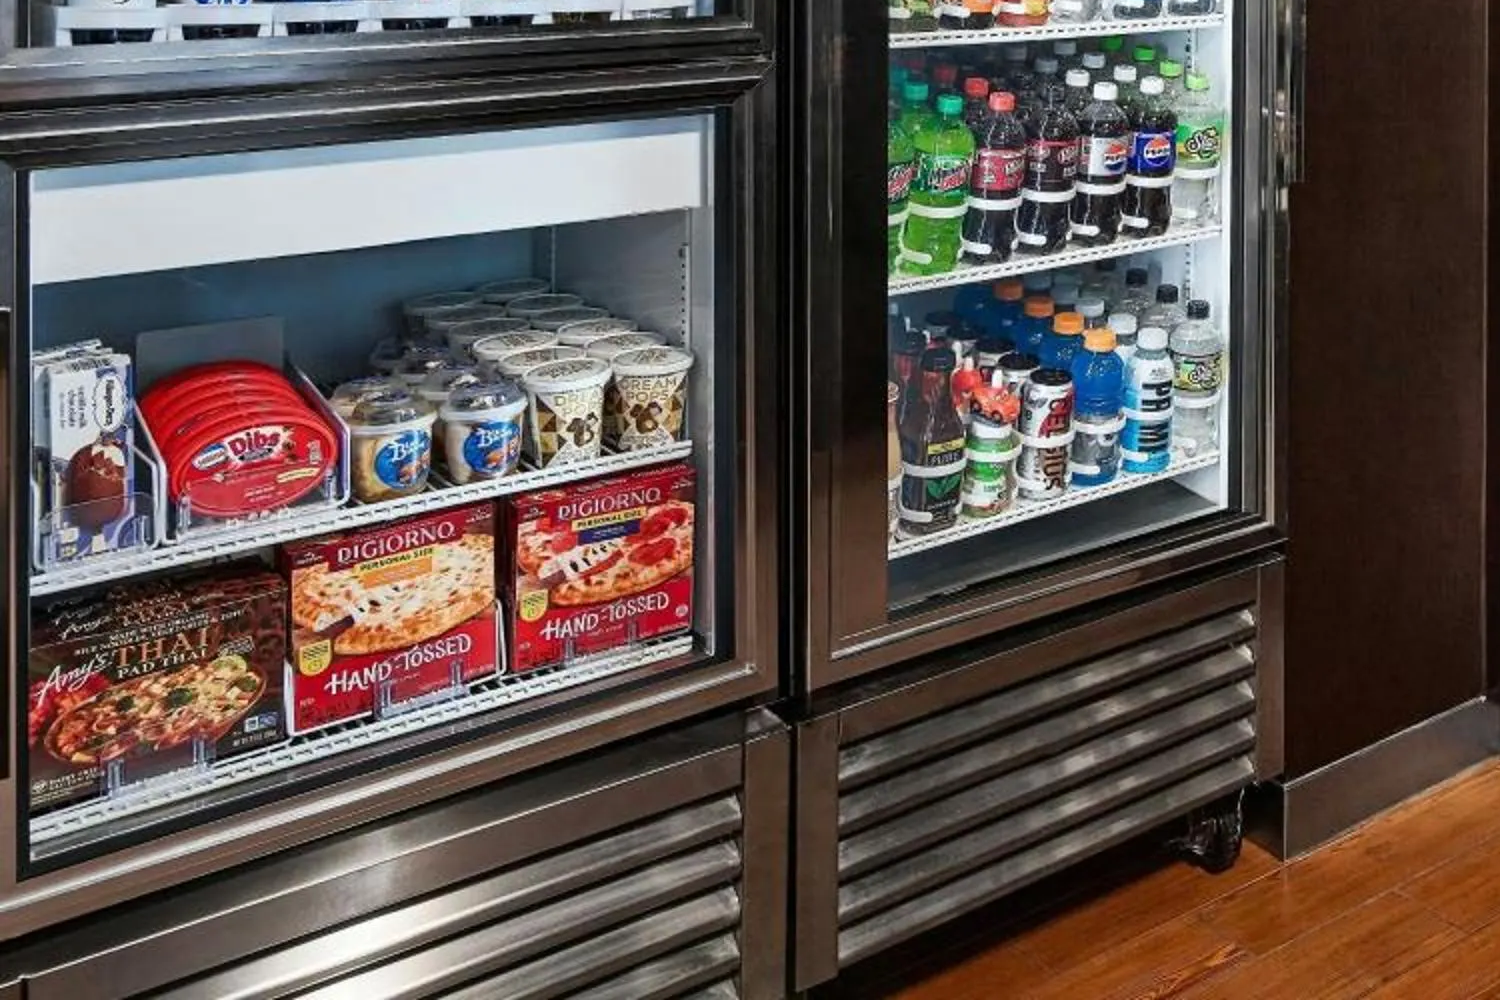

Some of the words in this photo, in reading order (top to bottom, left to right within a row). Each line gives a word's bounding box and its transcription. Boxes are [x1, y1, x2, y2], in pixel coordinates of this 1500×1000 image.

[227, 429, 282, 456] Dibs
[557, 486, 663, 521] DIGIORNO
[337, 520, 456, 565] DIGIORNO
[117, 662, 156, 680] PAD
[160, 648, 207, 669] THAI
